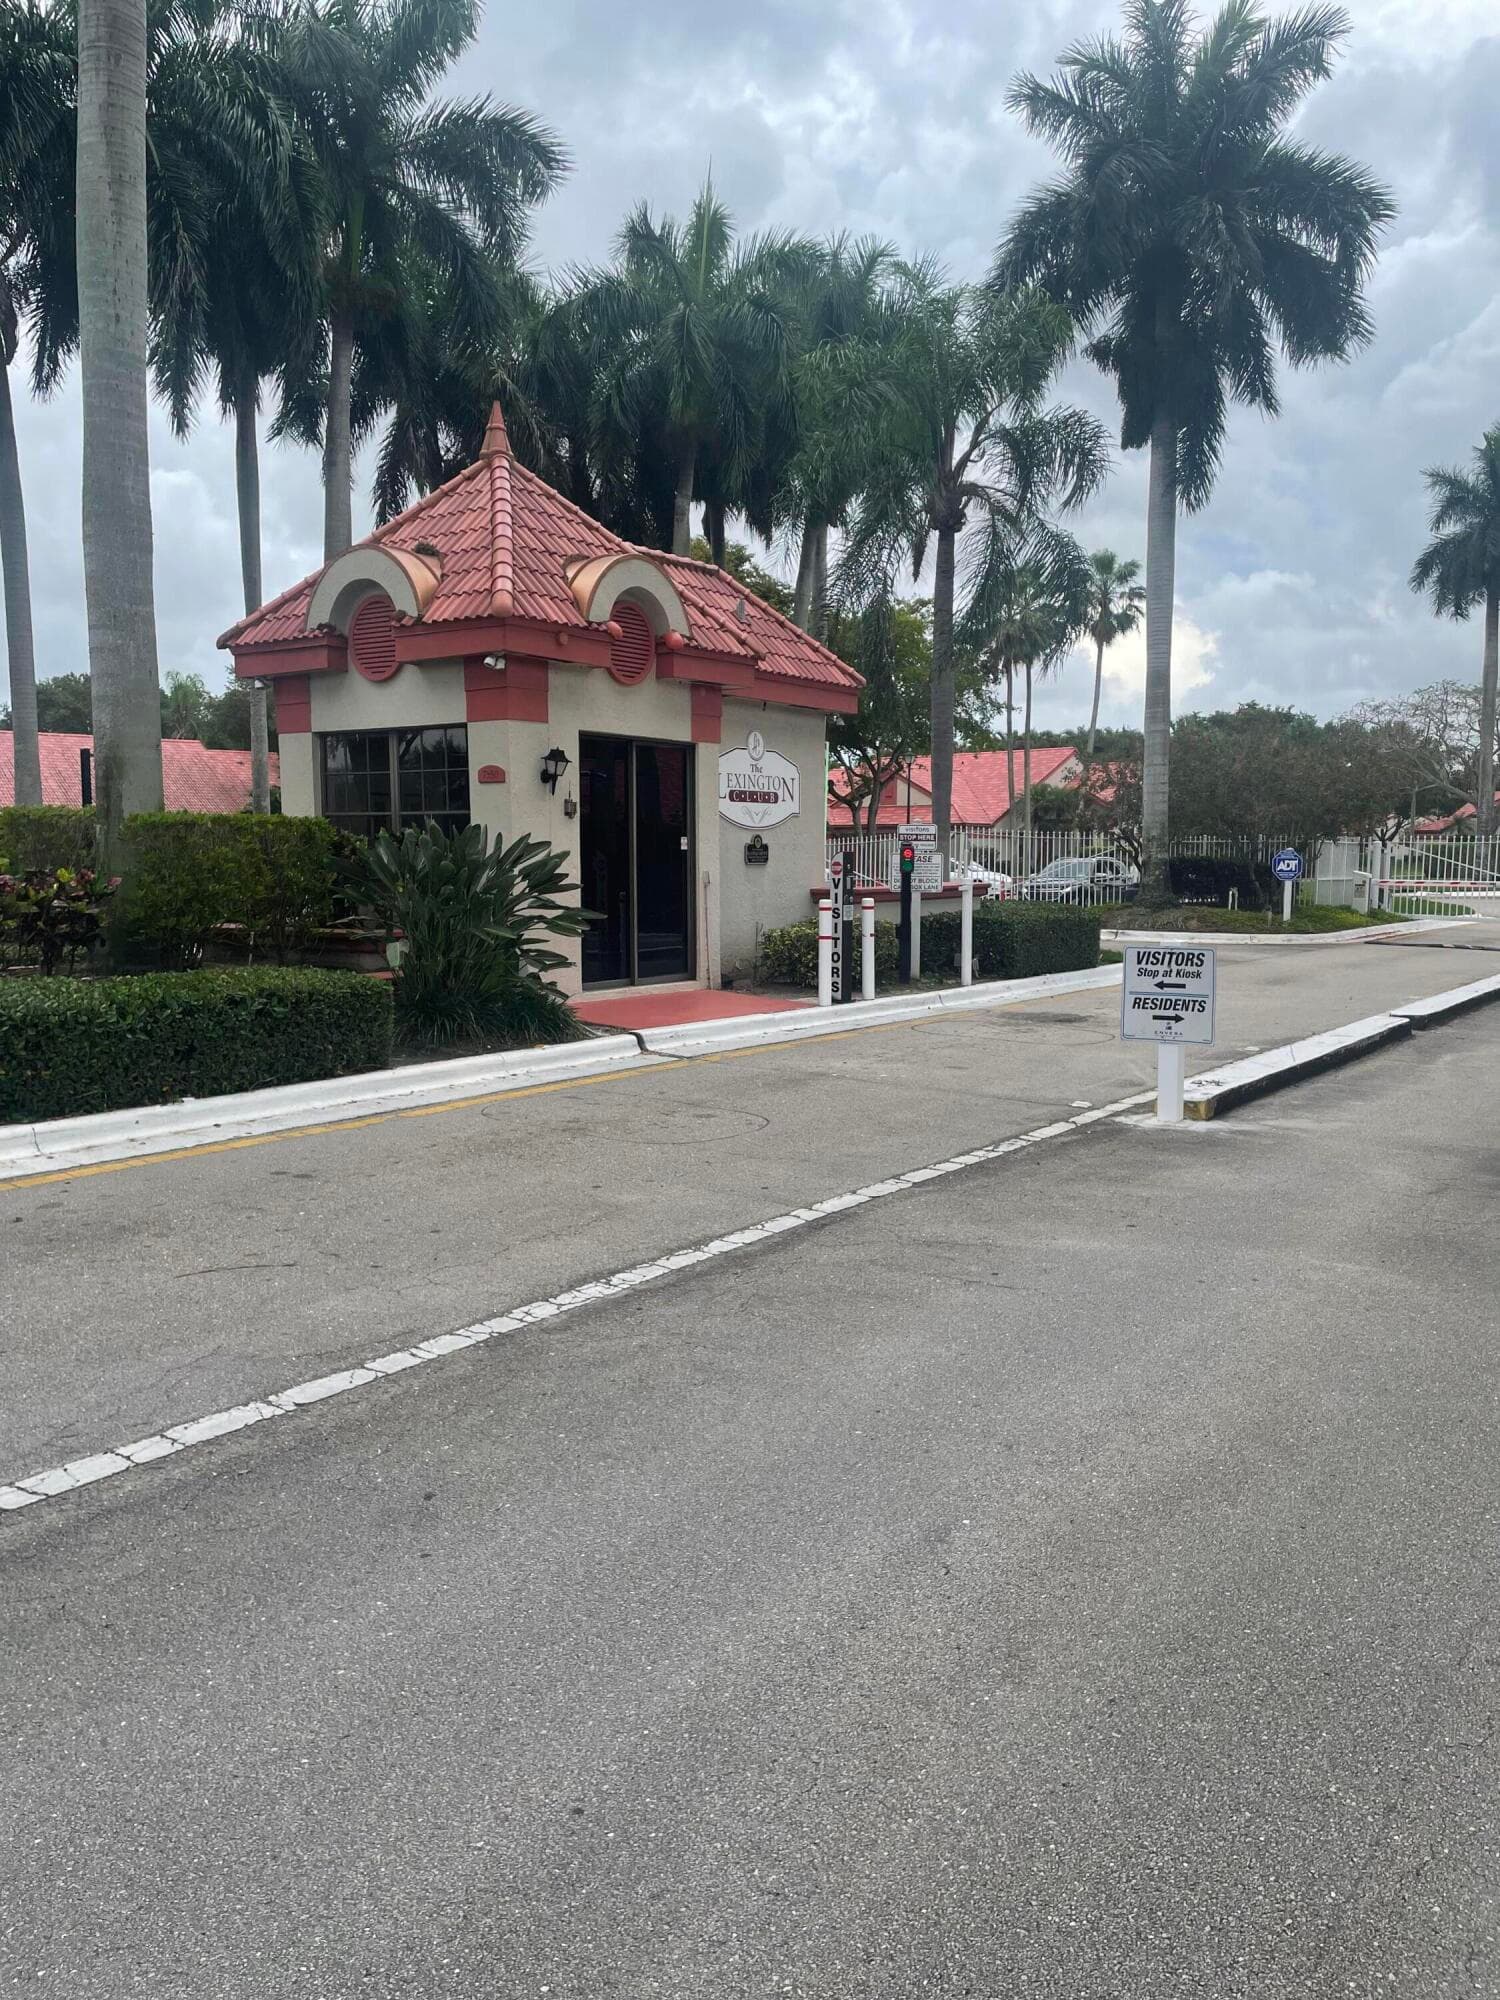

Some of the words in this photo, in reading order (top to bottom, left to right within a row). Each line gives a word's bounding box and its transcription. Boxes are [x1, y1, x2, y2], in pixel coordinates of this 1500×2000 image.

[750, 763, 763, 773] The
[1277, 860, 1298, 871] ADT
[831, 877, 841, 993] VISITORS
[1136, 951, 1206, 967] VISITORS
[1137, 967, 1159, 979] Stop
[1162, 968, 1173, 978] at
[1175, 968, 1202, 979] Kiosk
[1132, 997, 1207, 1013] RESIDENTS
